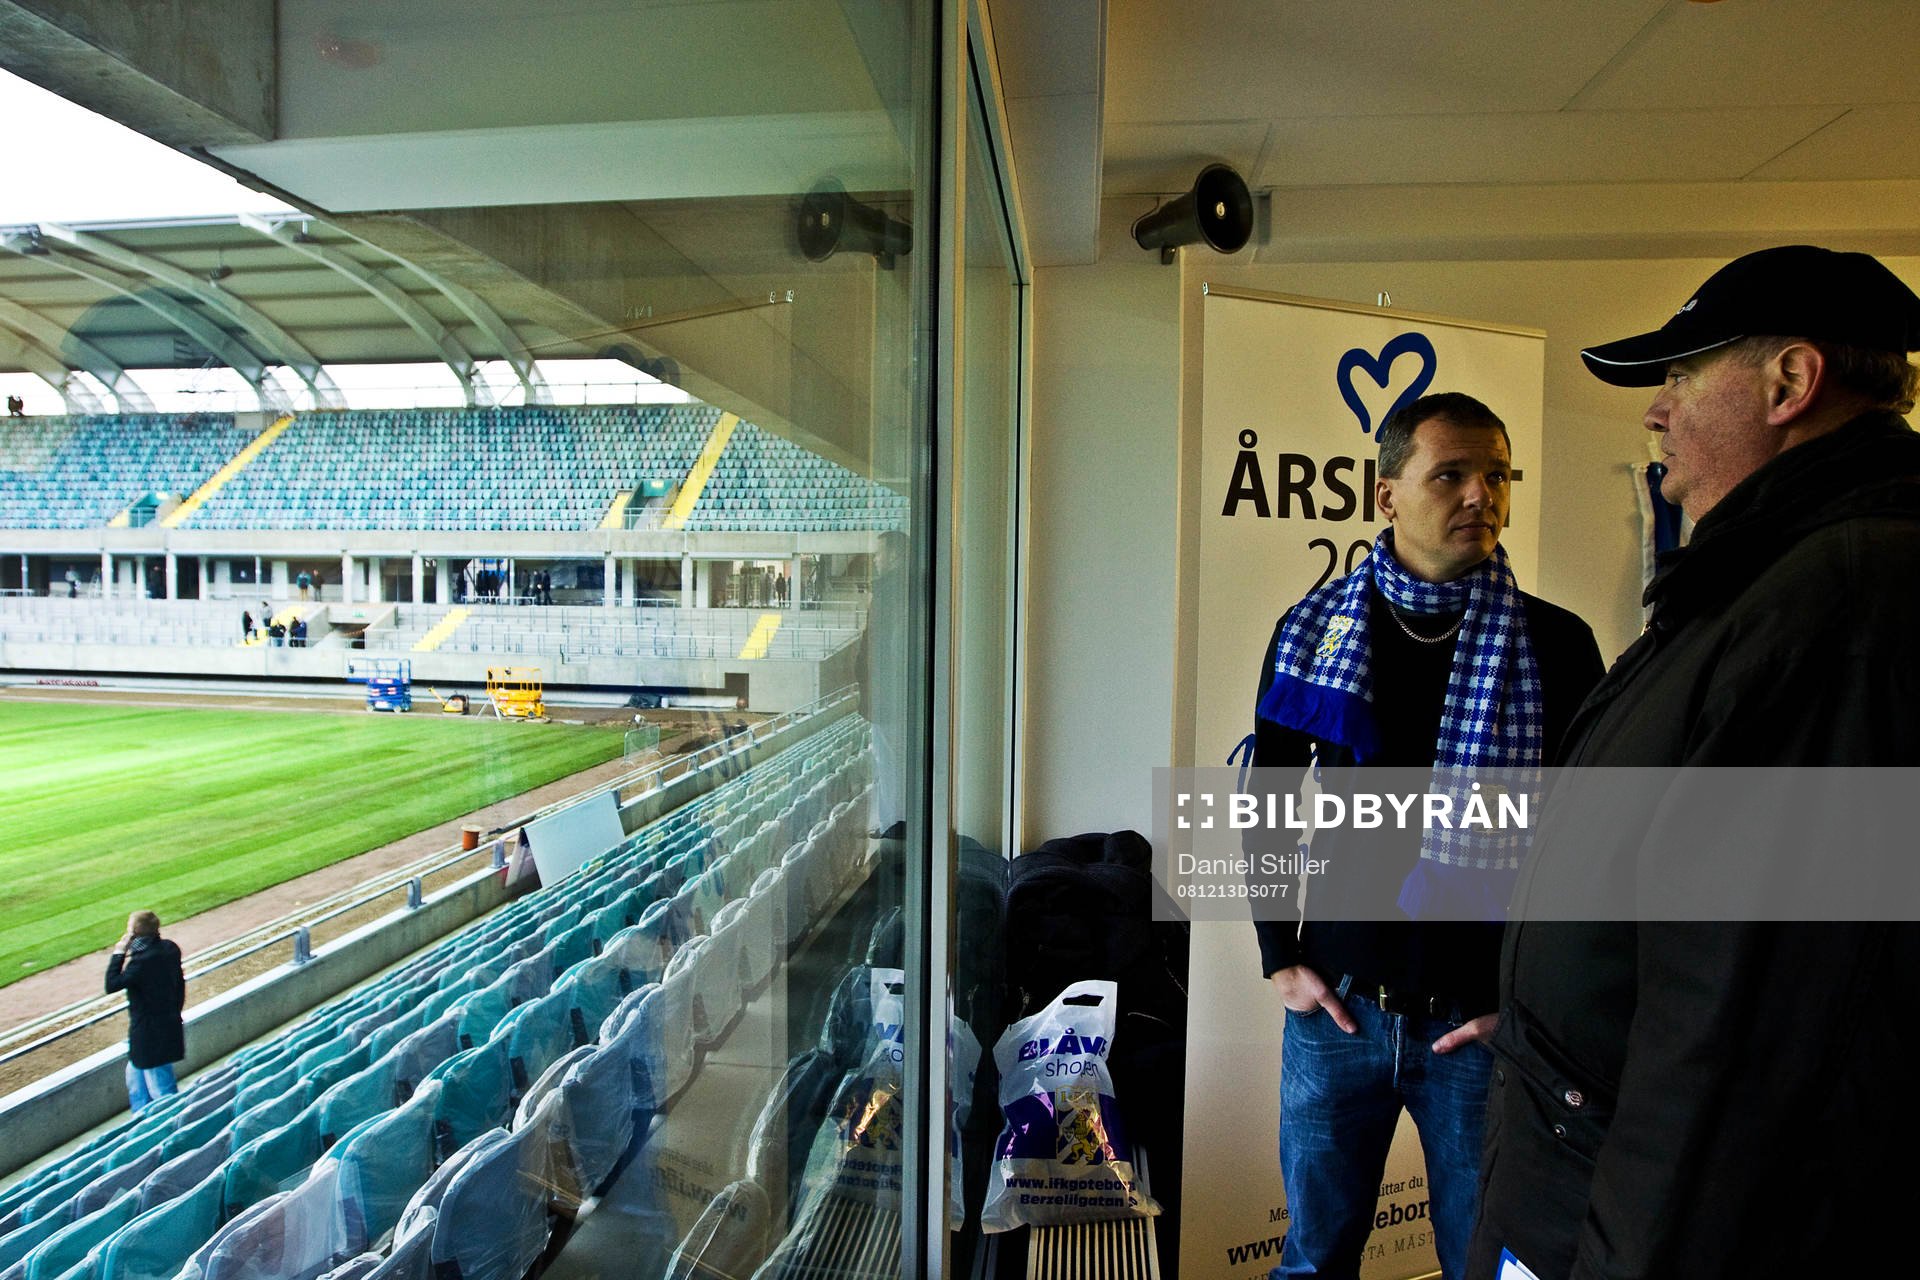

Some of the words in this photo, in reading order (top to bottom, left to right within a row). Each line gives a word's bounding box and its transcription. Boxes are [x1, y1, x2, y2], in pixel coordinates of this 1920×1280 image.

[1308, 538, 1373, 596] 20
[1018, 1027, 1107, 1062] BLÅV
[1269, 1207, 1289, 1223] Me
[1380, 1181, 1406, 1197] ittar
[1408, 1176, 1424, 1190] du
[1374, 1200, 1431, 1229] ebor
